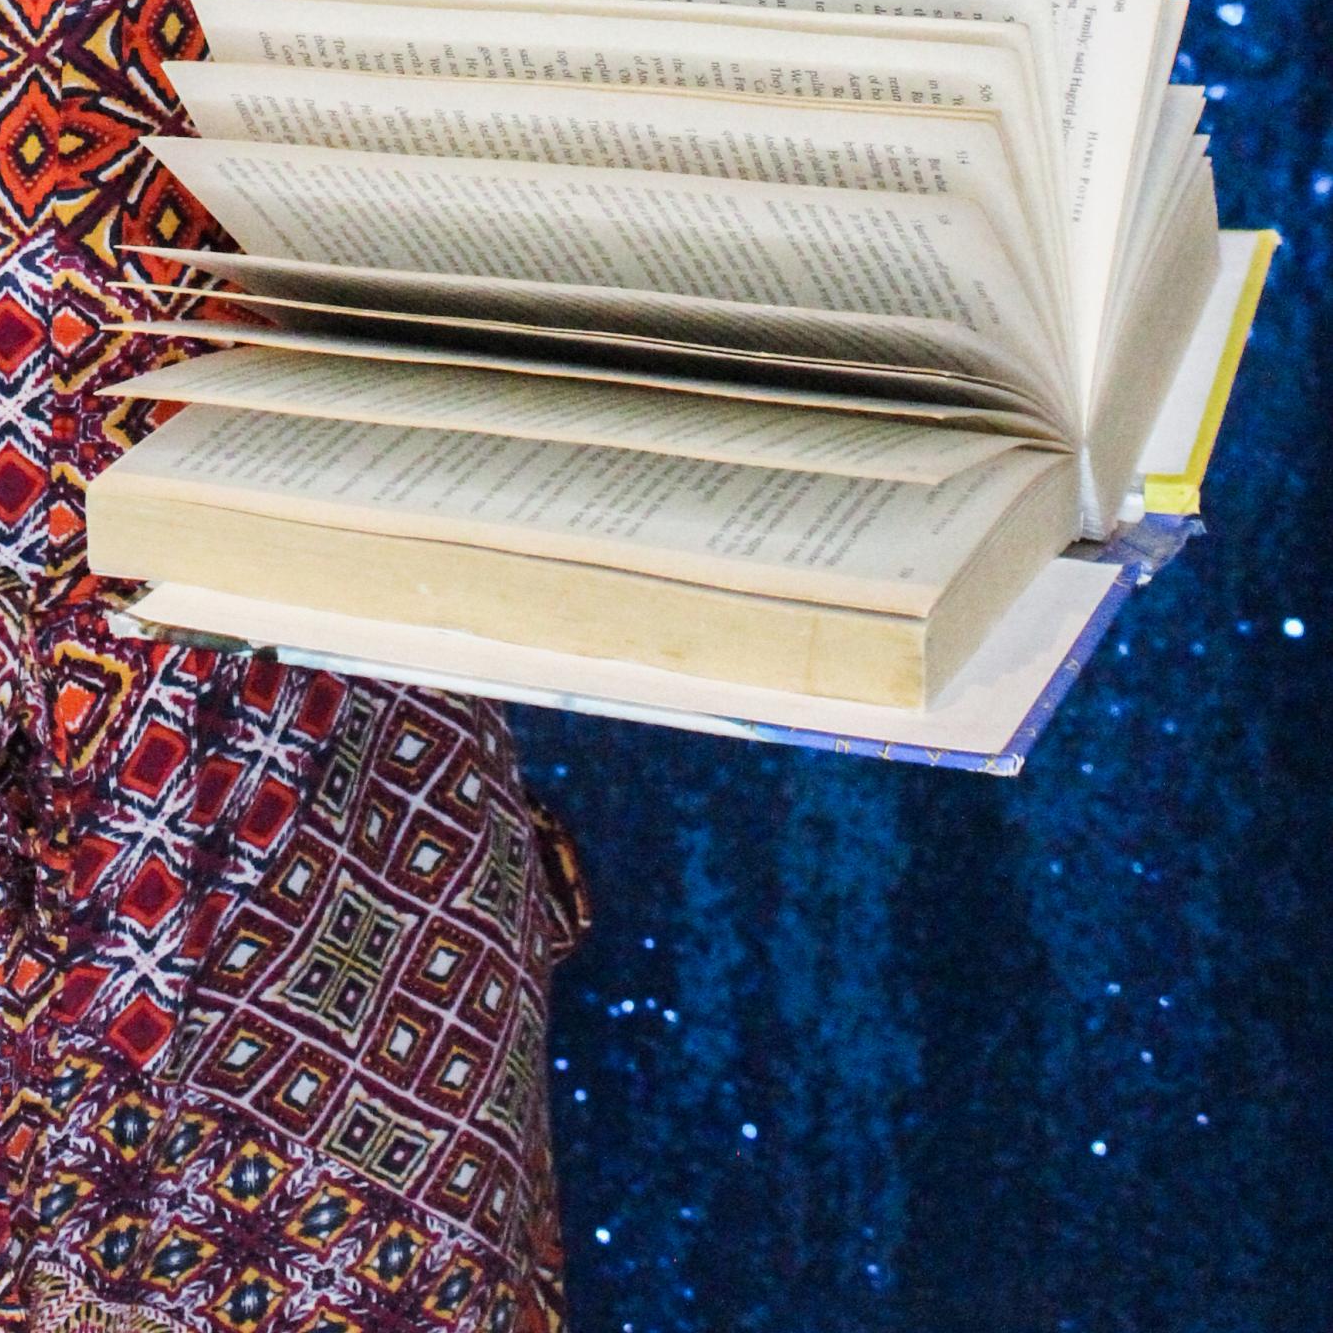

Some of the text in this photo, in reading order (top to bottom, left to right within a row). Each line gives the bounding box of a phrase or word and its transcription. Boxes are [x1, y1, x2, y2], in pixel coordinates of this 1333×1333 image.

[730, 63, 740, 72] to
[1073, 53, 1086, 74] said
[710, 62, 725, 87] never
[868, 75, 880, 84] of
[928, 80, 939, 89] in
[978, 85, 993, 102] 506
[1065, 77, 1082, 115] Hagrid
[1072, 132, 1098, 223] HARRY POTTER
